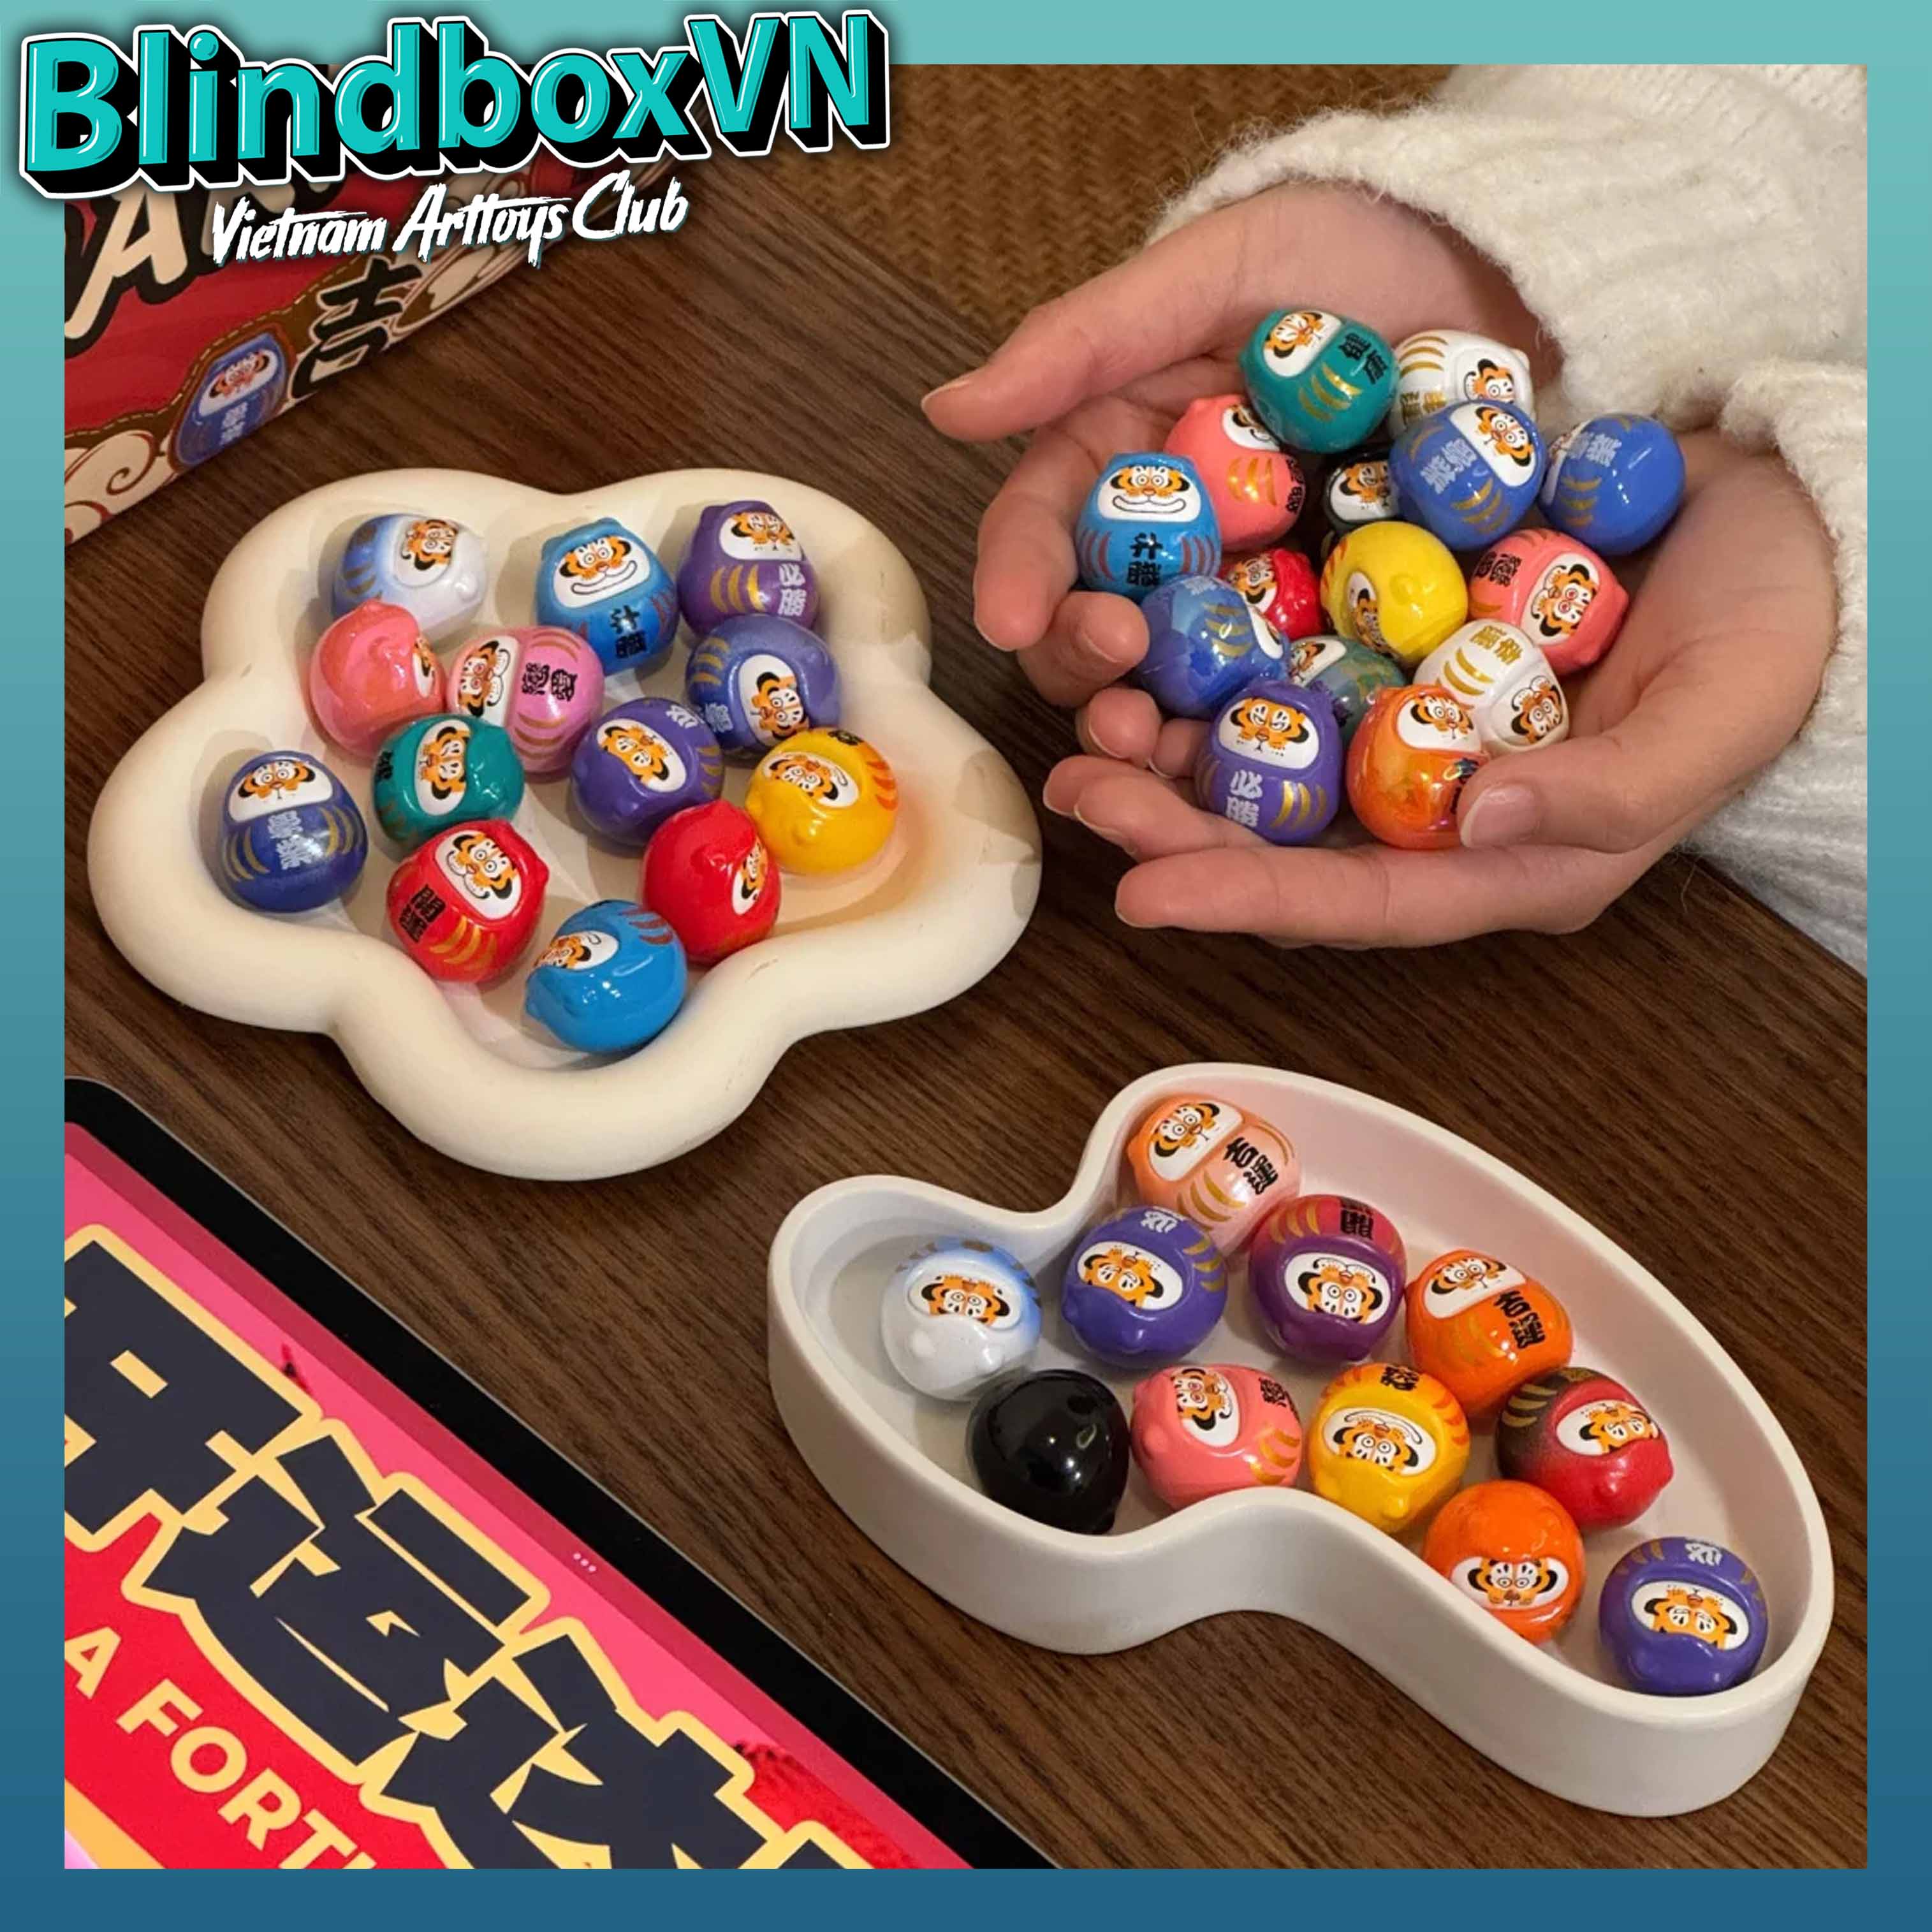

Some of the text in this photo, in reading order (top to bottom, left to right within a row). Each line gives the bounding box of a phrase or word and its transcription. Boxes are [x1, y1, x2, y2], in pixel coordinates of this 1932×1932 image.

[64, 1241, 845, 1868] 开运达
[115, 1678, 376, 1868] FORT
